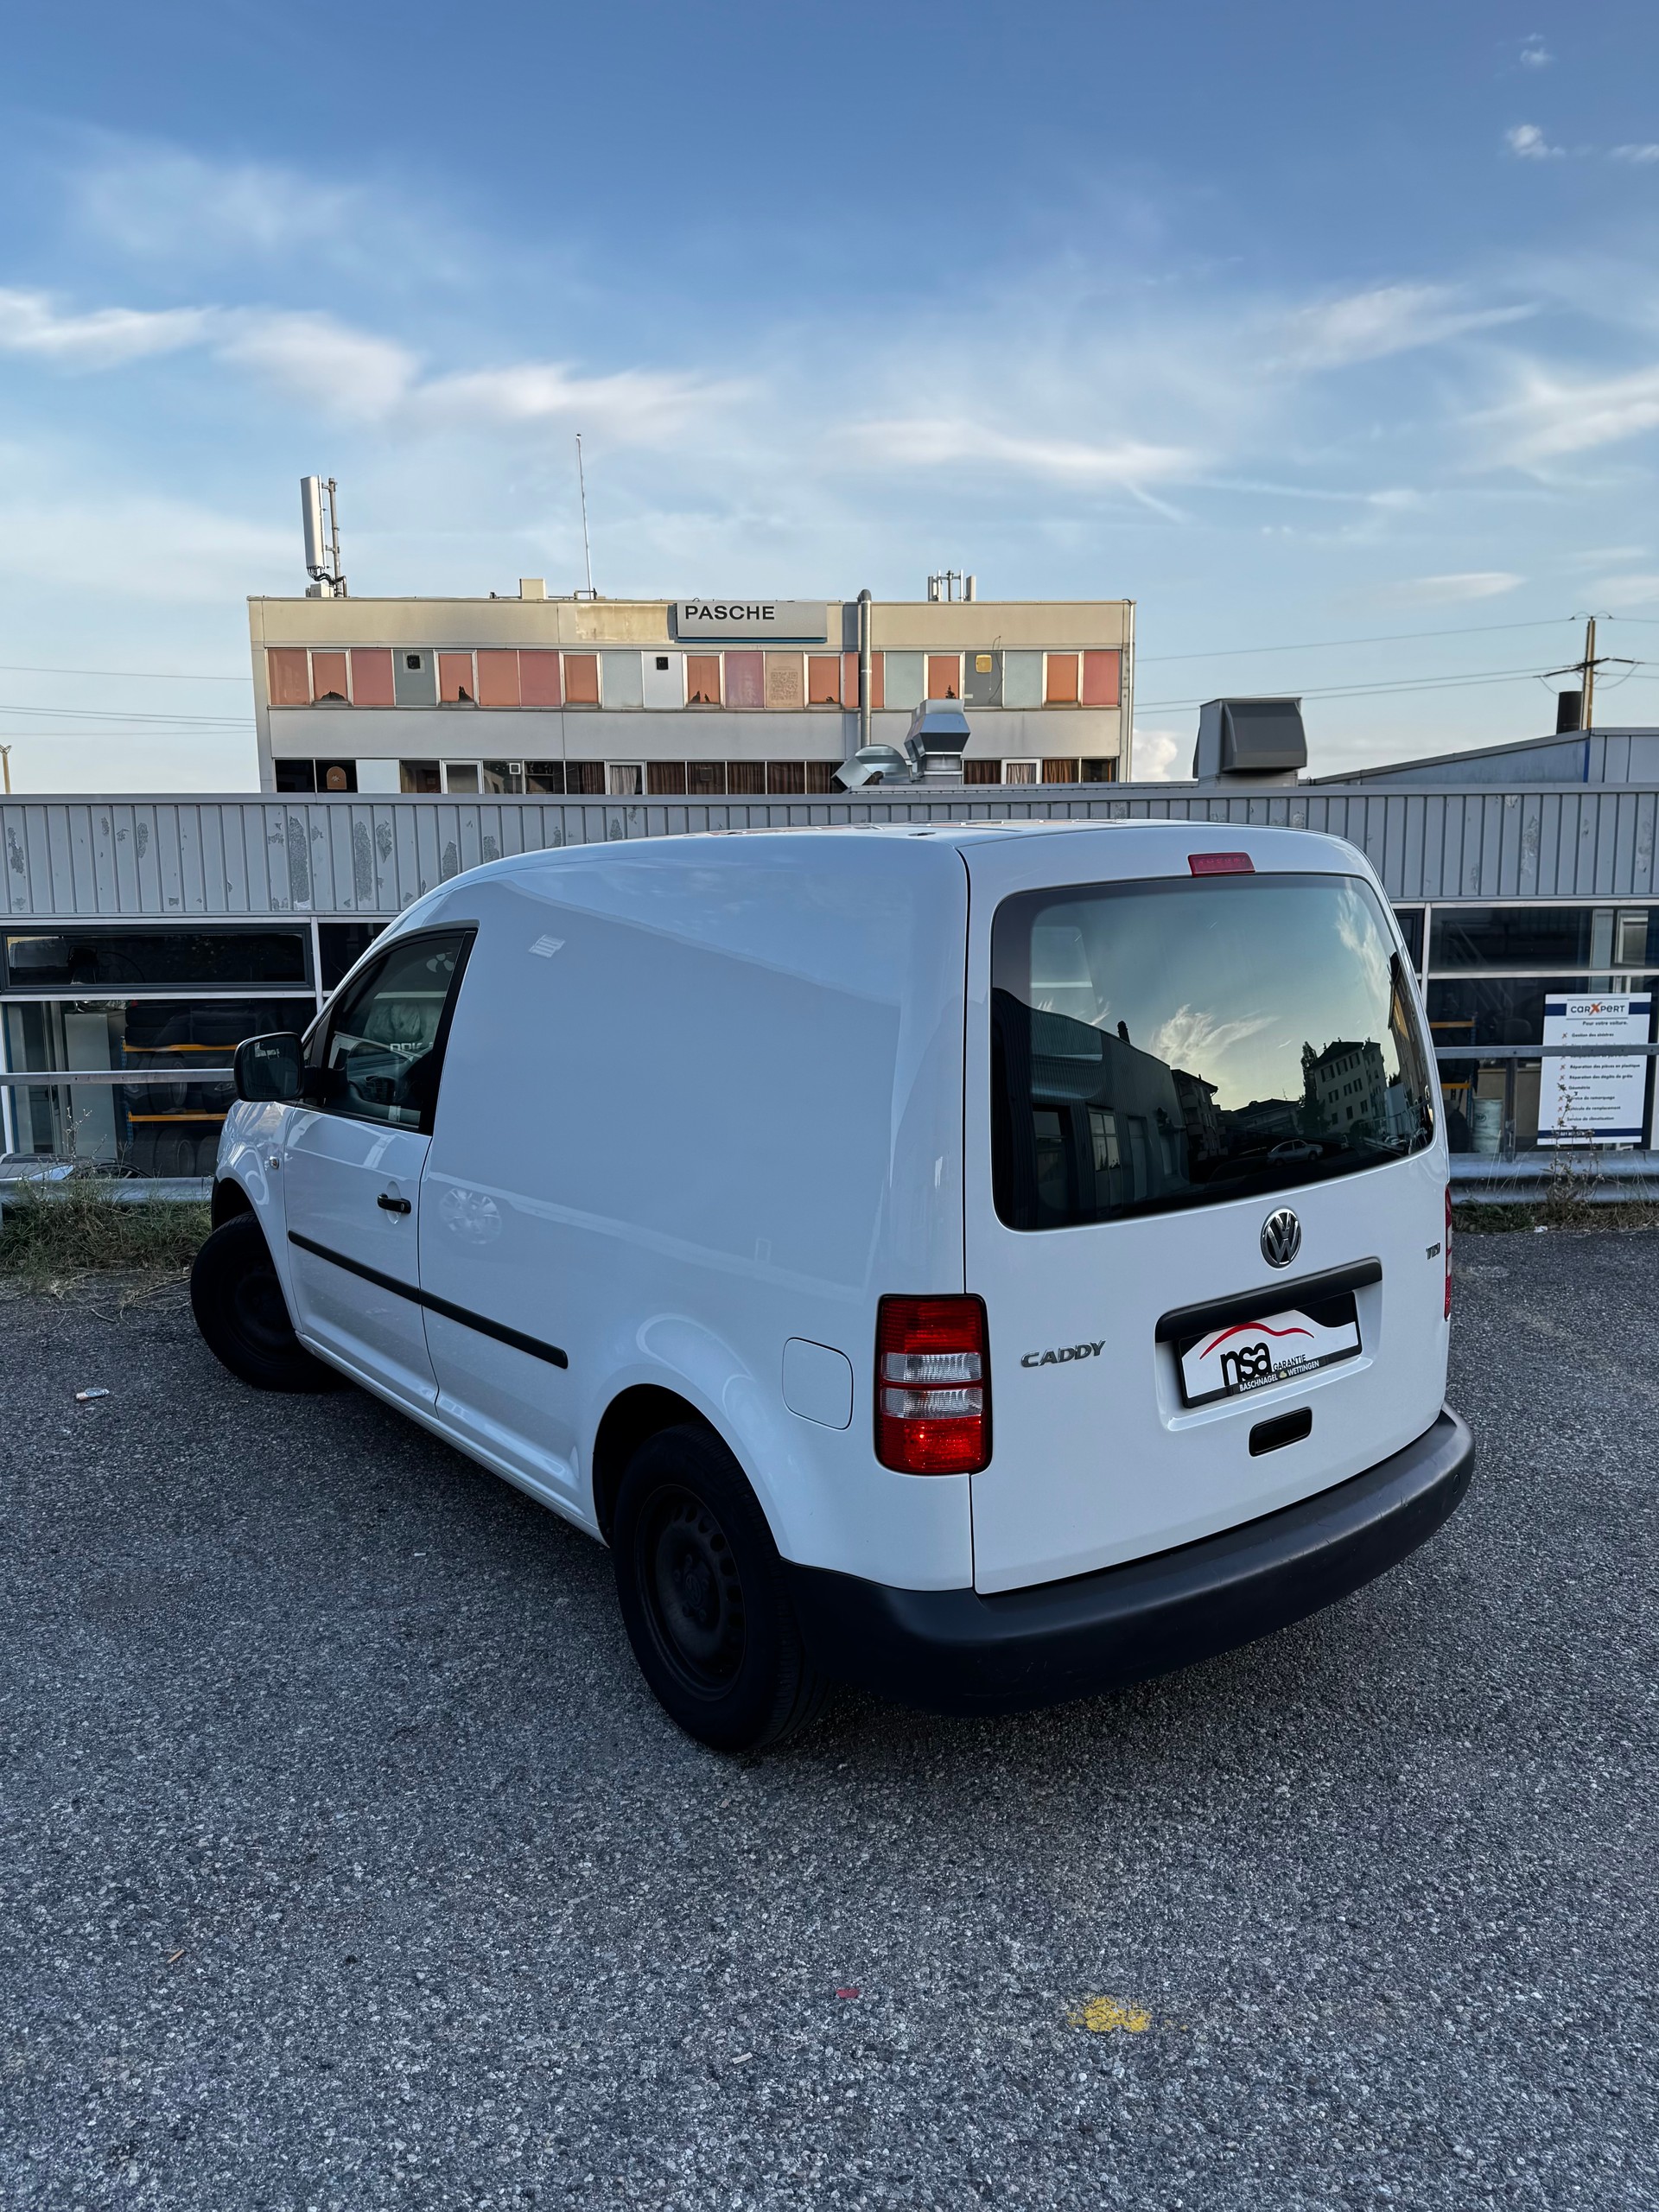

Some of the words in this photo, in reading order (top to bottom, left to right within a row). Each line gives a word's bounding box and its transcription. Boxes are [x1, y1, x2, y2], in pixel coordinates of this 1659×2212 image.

[685, 606, 775, 620] PASCHE
[1020, 1339, 1107, 1368] CADDY
[1220, 1342, 1273, 1387] nsa
[1273, 1354, 1306, 1372] GARANTIE
[1239, 1373, 1279, 1392] BASCHNAGEL
[1287, 1359, 1320, 1376] WETTINGEN
